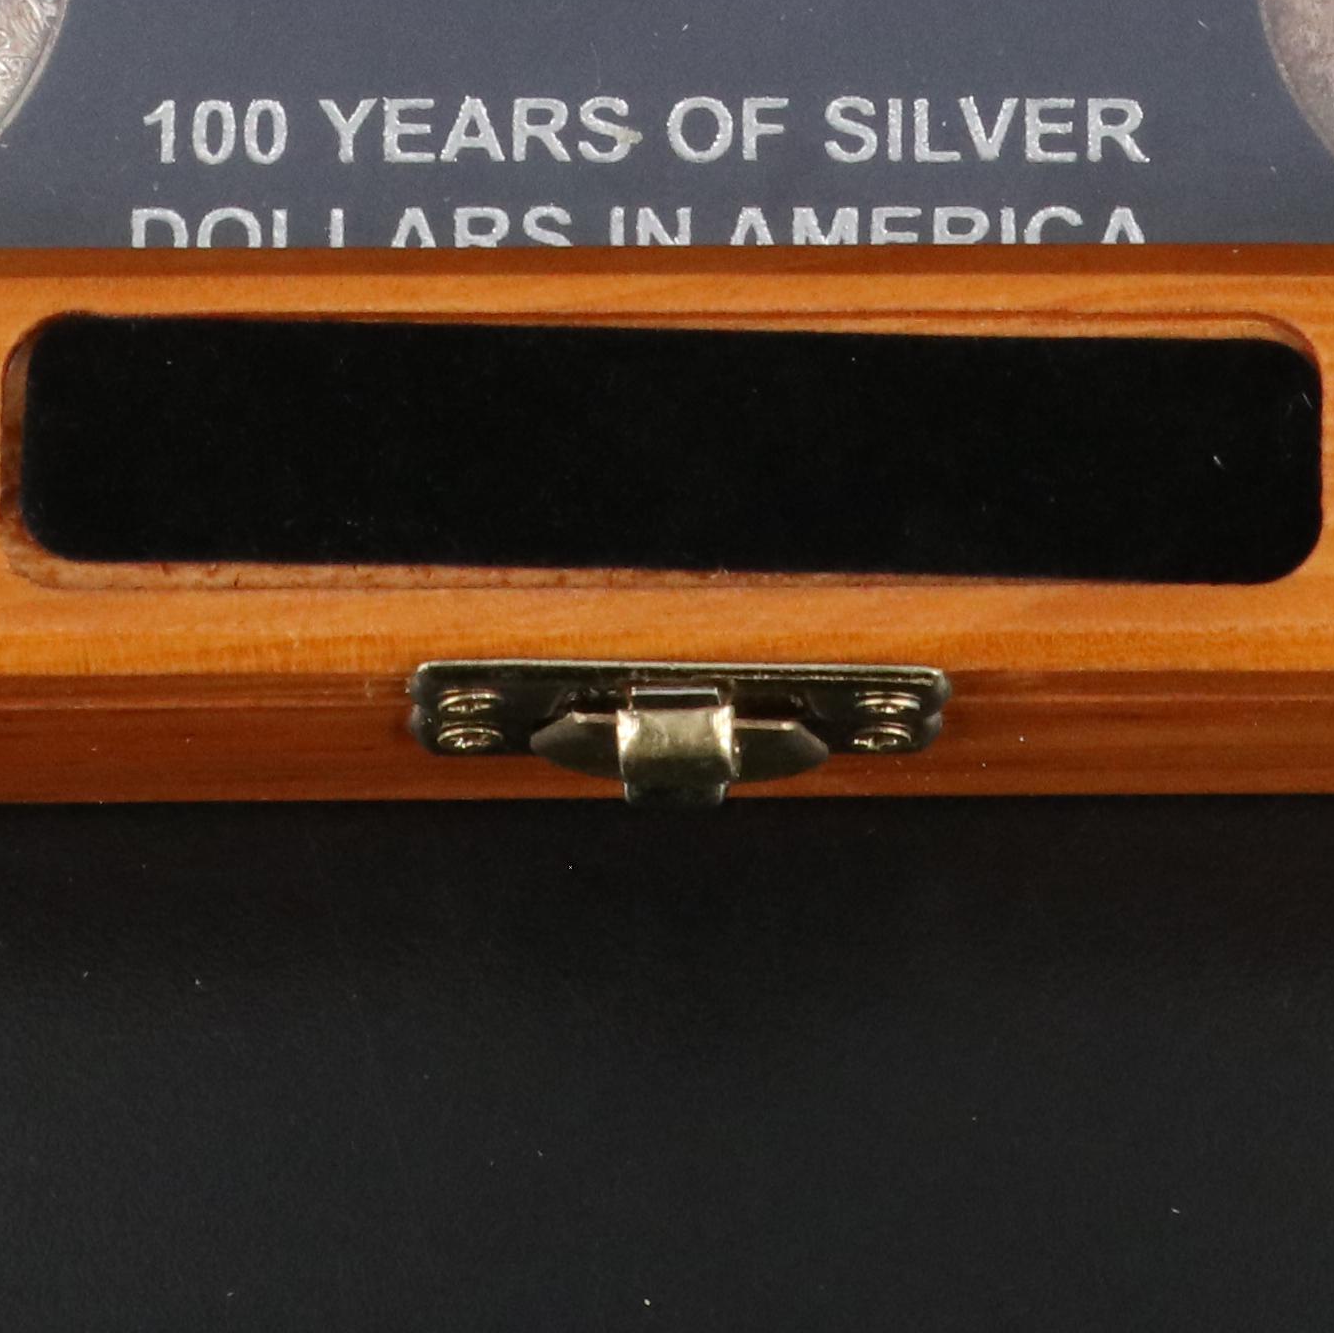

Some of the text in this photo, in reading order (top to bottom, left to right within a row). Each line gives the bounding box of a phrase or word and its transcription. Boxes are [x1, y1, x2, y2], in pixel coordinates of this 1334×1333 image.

[143, 95, 1150, 165] 100 YEARS OF SILVER
[131, 205, 1146, 248] DOLLARS IN AMERICA
